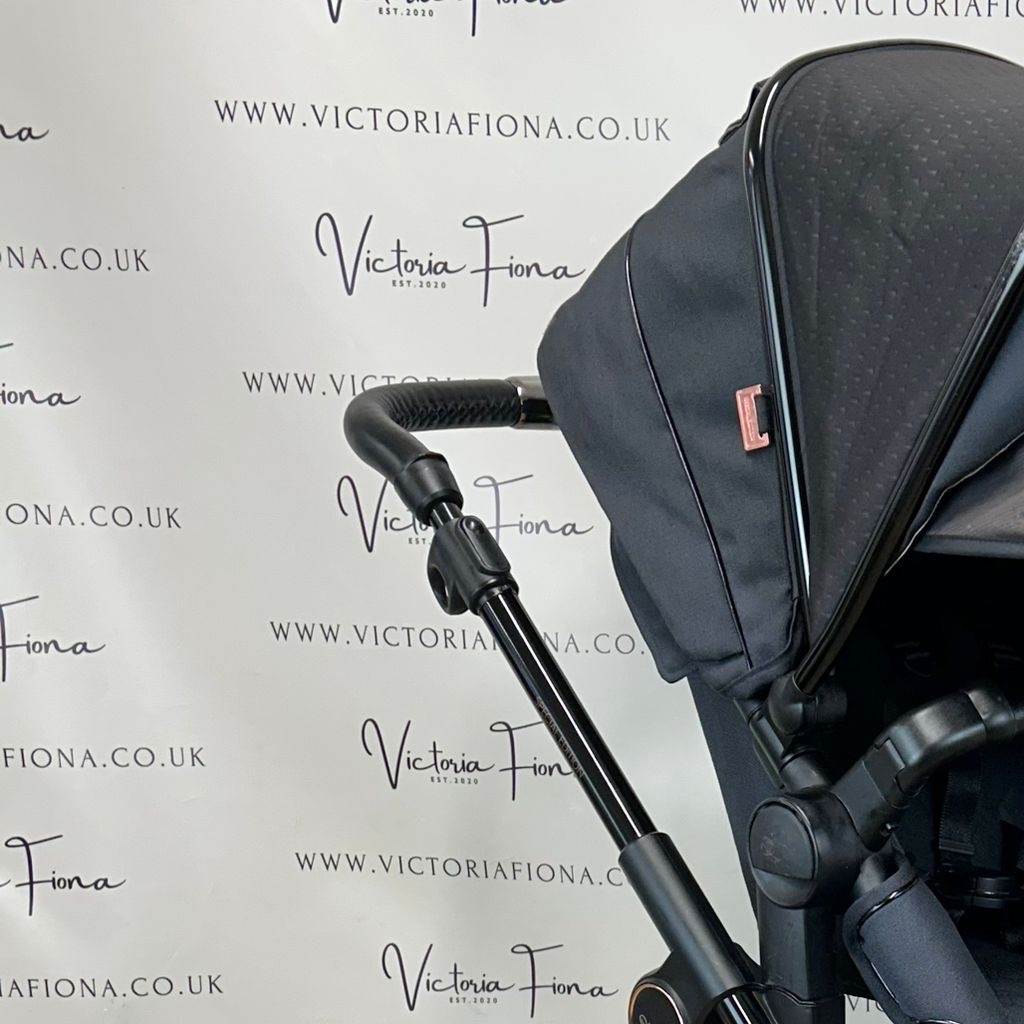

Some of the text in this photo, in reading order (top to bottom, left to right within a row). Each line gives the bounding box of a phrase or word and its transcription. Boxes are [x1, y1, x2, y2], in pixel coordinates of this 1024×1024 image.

[378, 7, 434, 17] EST.2020
[214, 99, 671, 142] WWW.VICTORIAFIONA.CO.UK
[0, 246, 150, 272] NA.CO.UK
[315, 212, 586, 307] Victoria Fiona
[391, 280, 447, 288] EST.2020
[5, 503, 182, 529] ONA.CO.UK
[3, 747, 206, 769] FIONA.CO.UK
[361, 718, 495, 790] Victoria
[4, 834, 127, 917] Fiona
[381, 942, 620, 1019] Victoria Fiona
